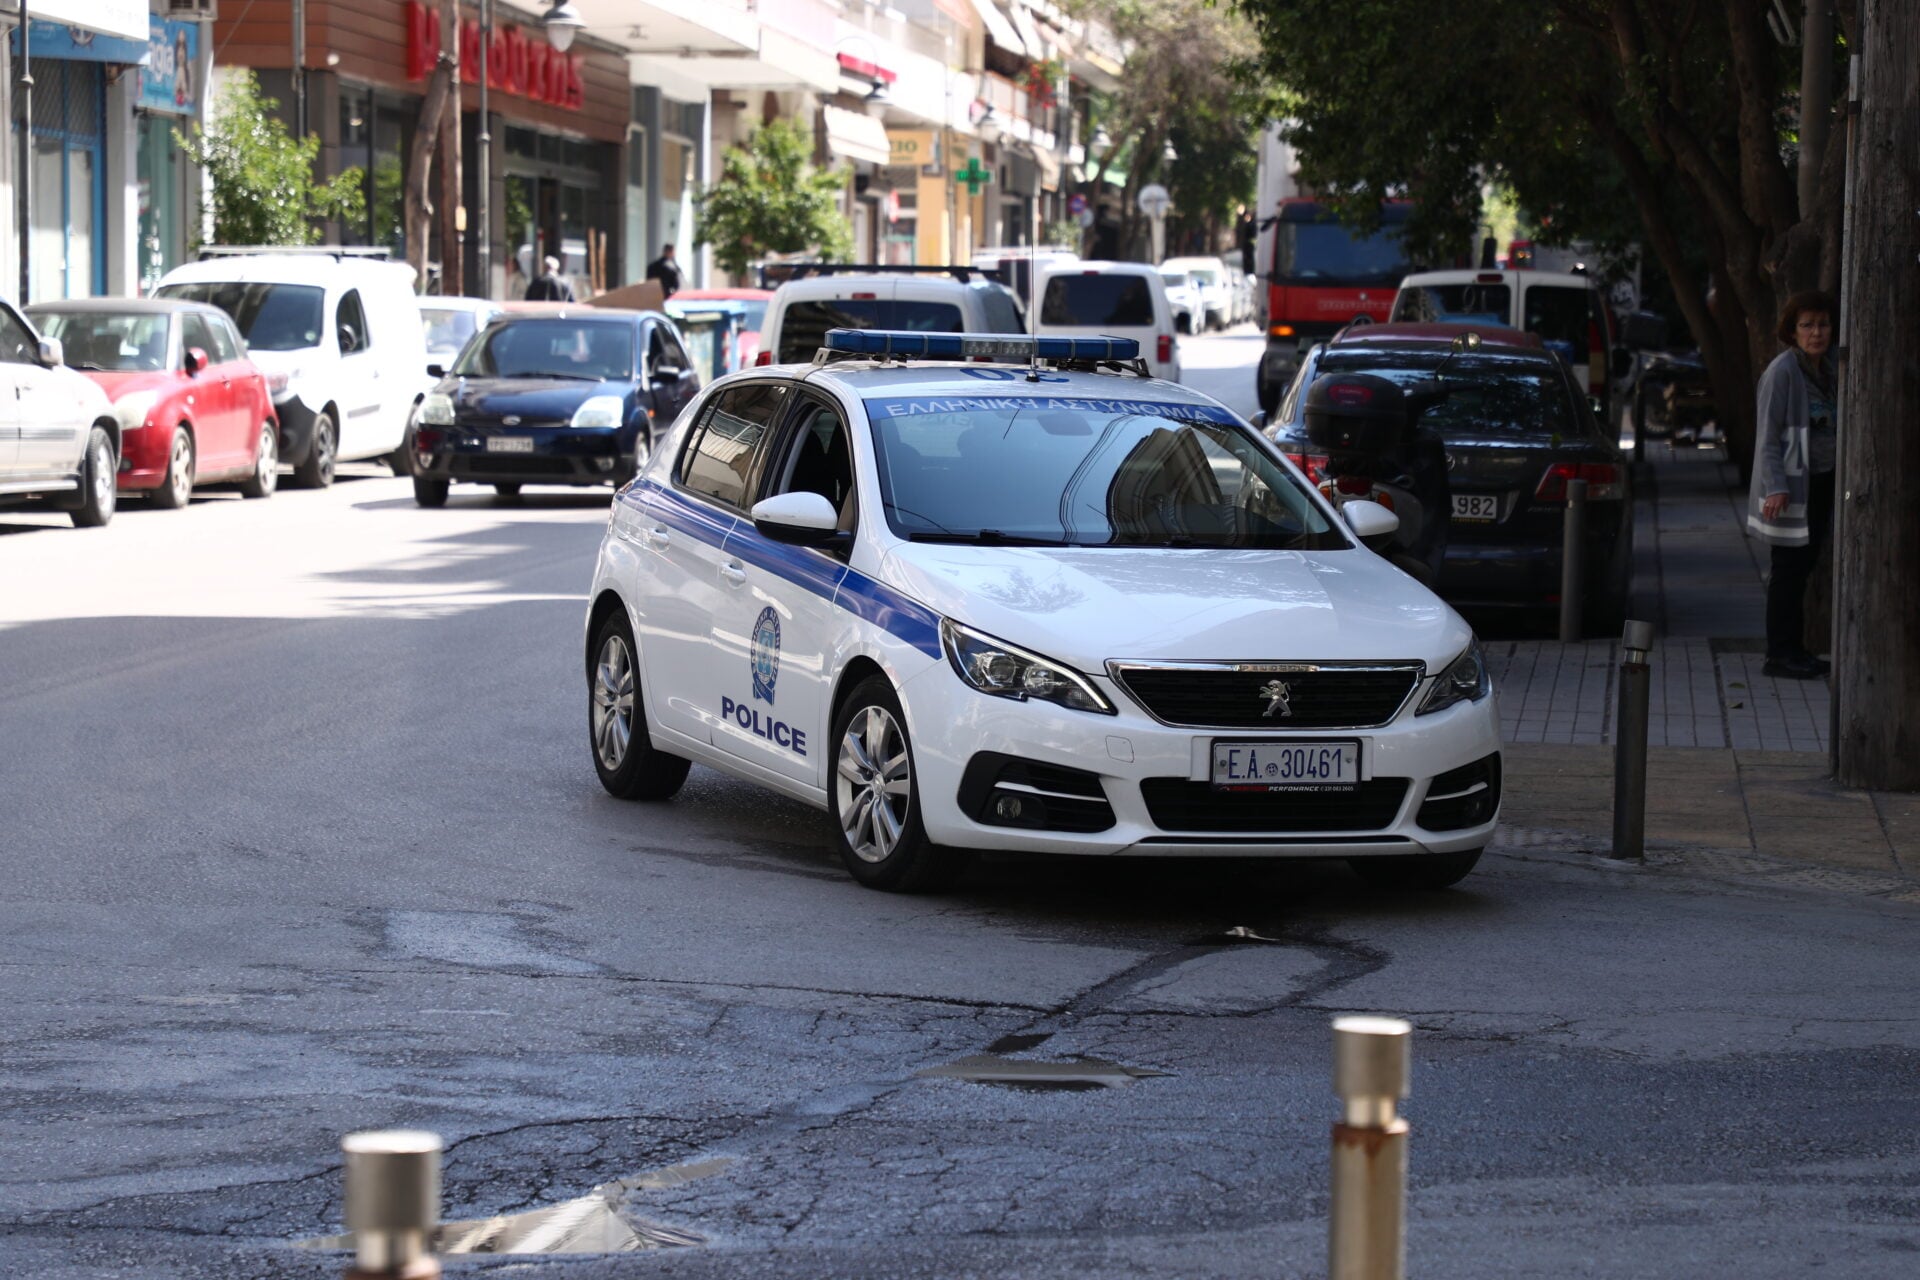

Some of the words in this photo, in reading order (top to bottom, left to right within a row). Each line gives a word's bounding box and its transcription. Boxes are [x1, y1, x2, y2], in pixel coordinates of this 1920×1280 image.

[886, 398, 1038, 417] ΕΛΛΗΝΙΚΗ
[1048, 398, 1214, 422] ΑΣΤΥΝΟΜΙΑ
[722, 695, 807, 756] POLICE
[1281, 749, 1341, 779] 30461
